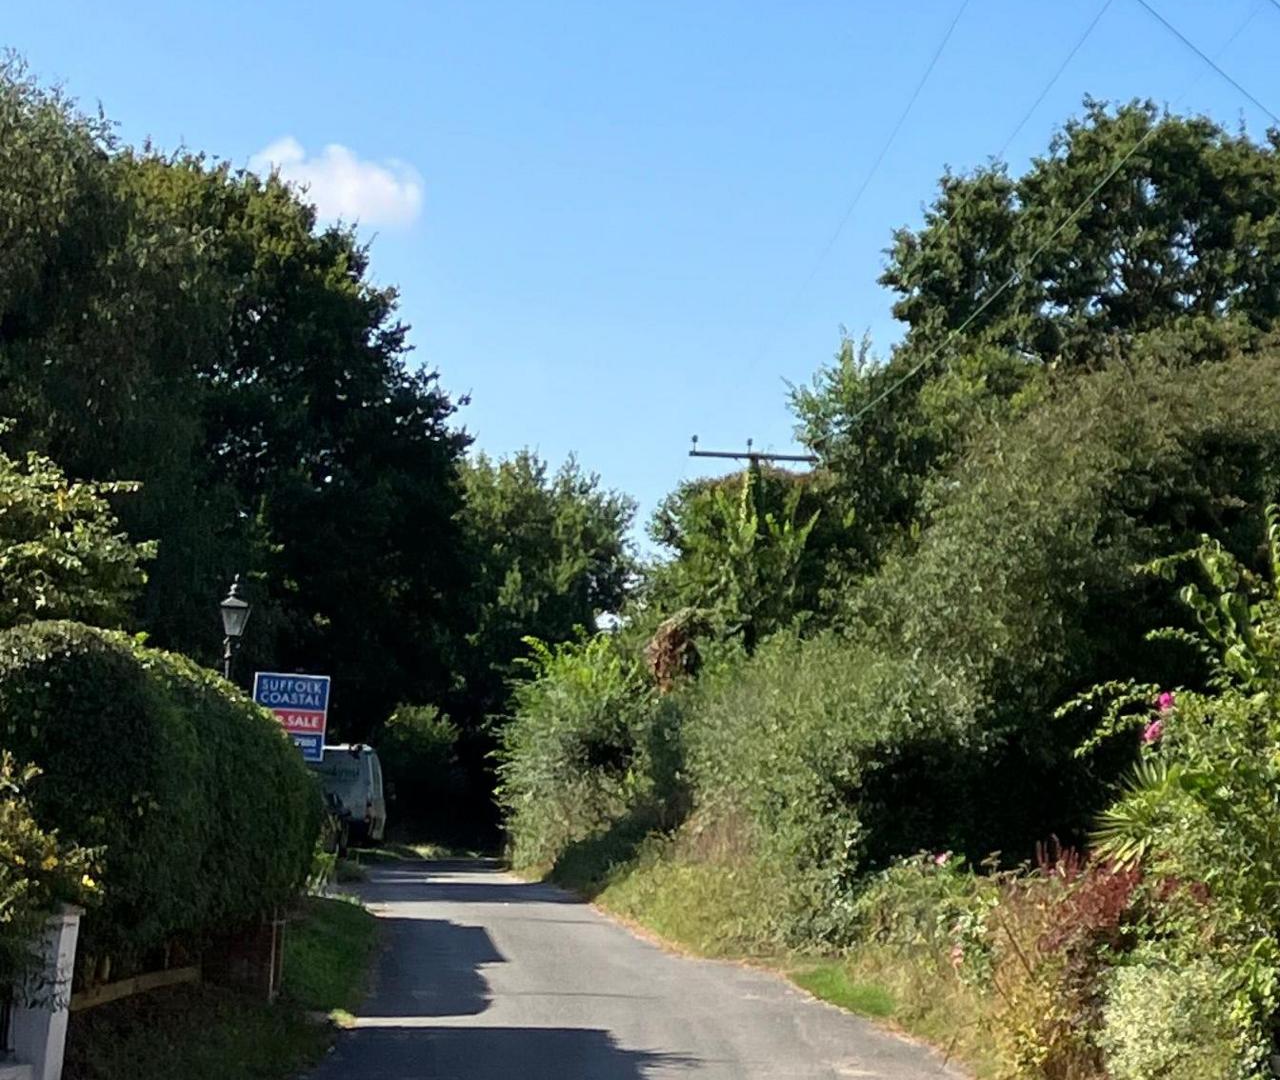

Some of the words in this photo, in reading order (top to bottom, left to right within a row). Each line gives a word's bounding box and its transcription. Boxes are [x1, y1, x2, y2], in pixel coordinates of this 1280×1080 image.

[262, 679, 322, 693] SUFFOLK
[260, 692, 320, 705] COASTAL
[287, 716, 319, 727] SALE
